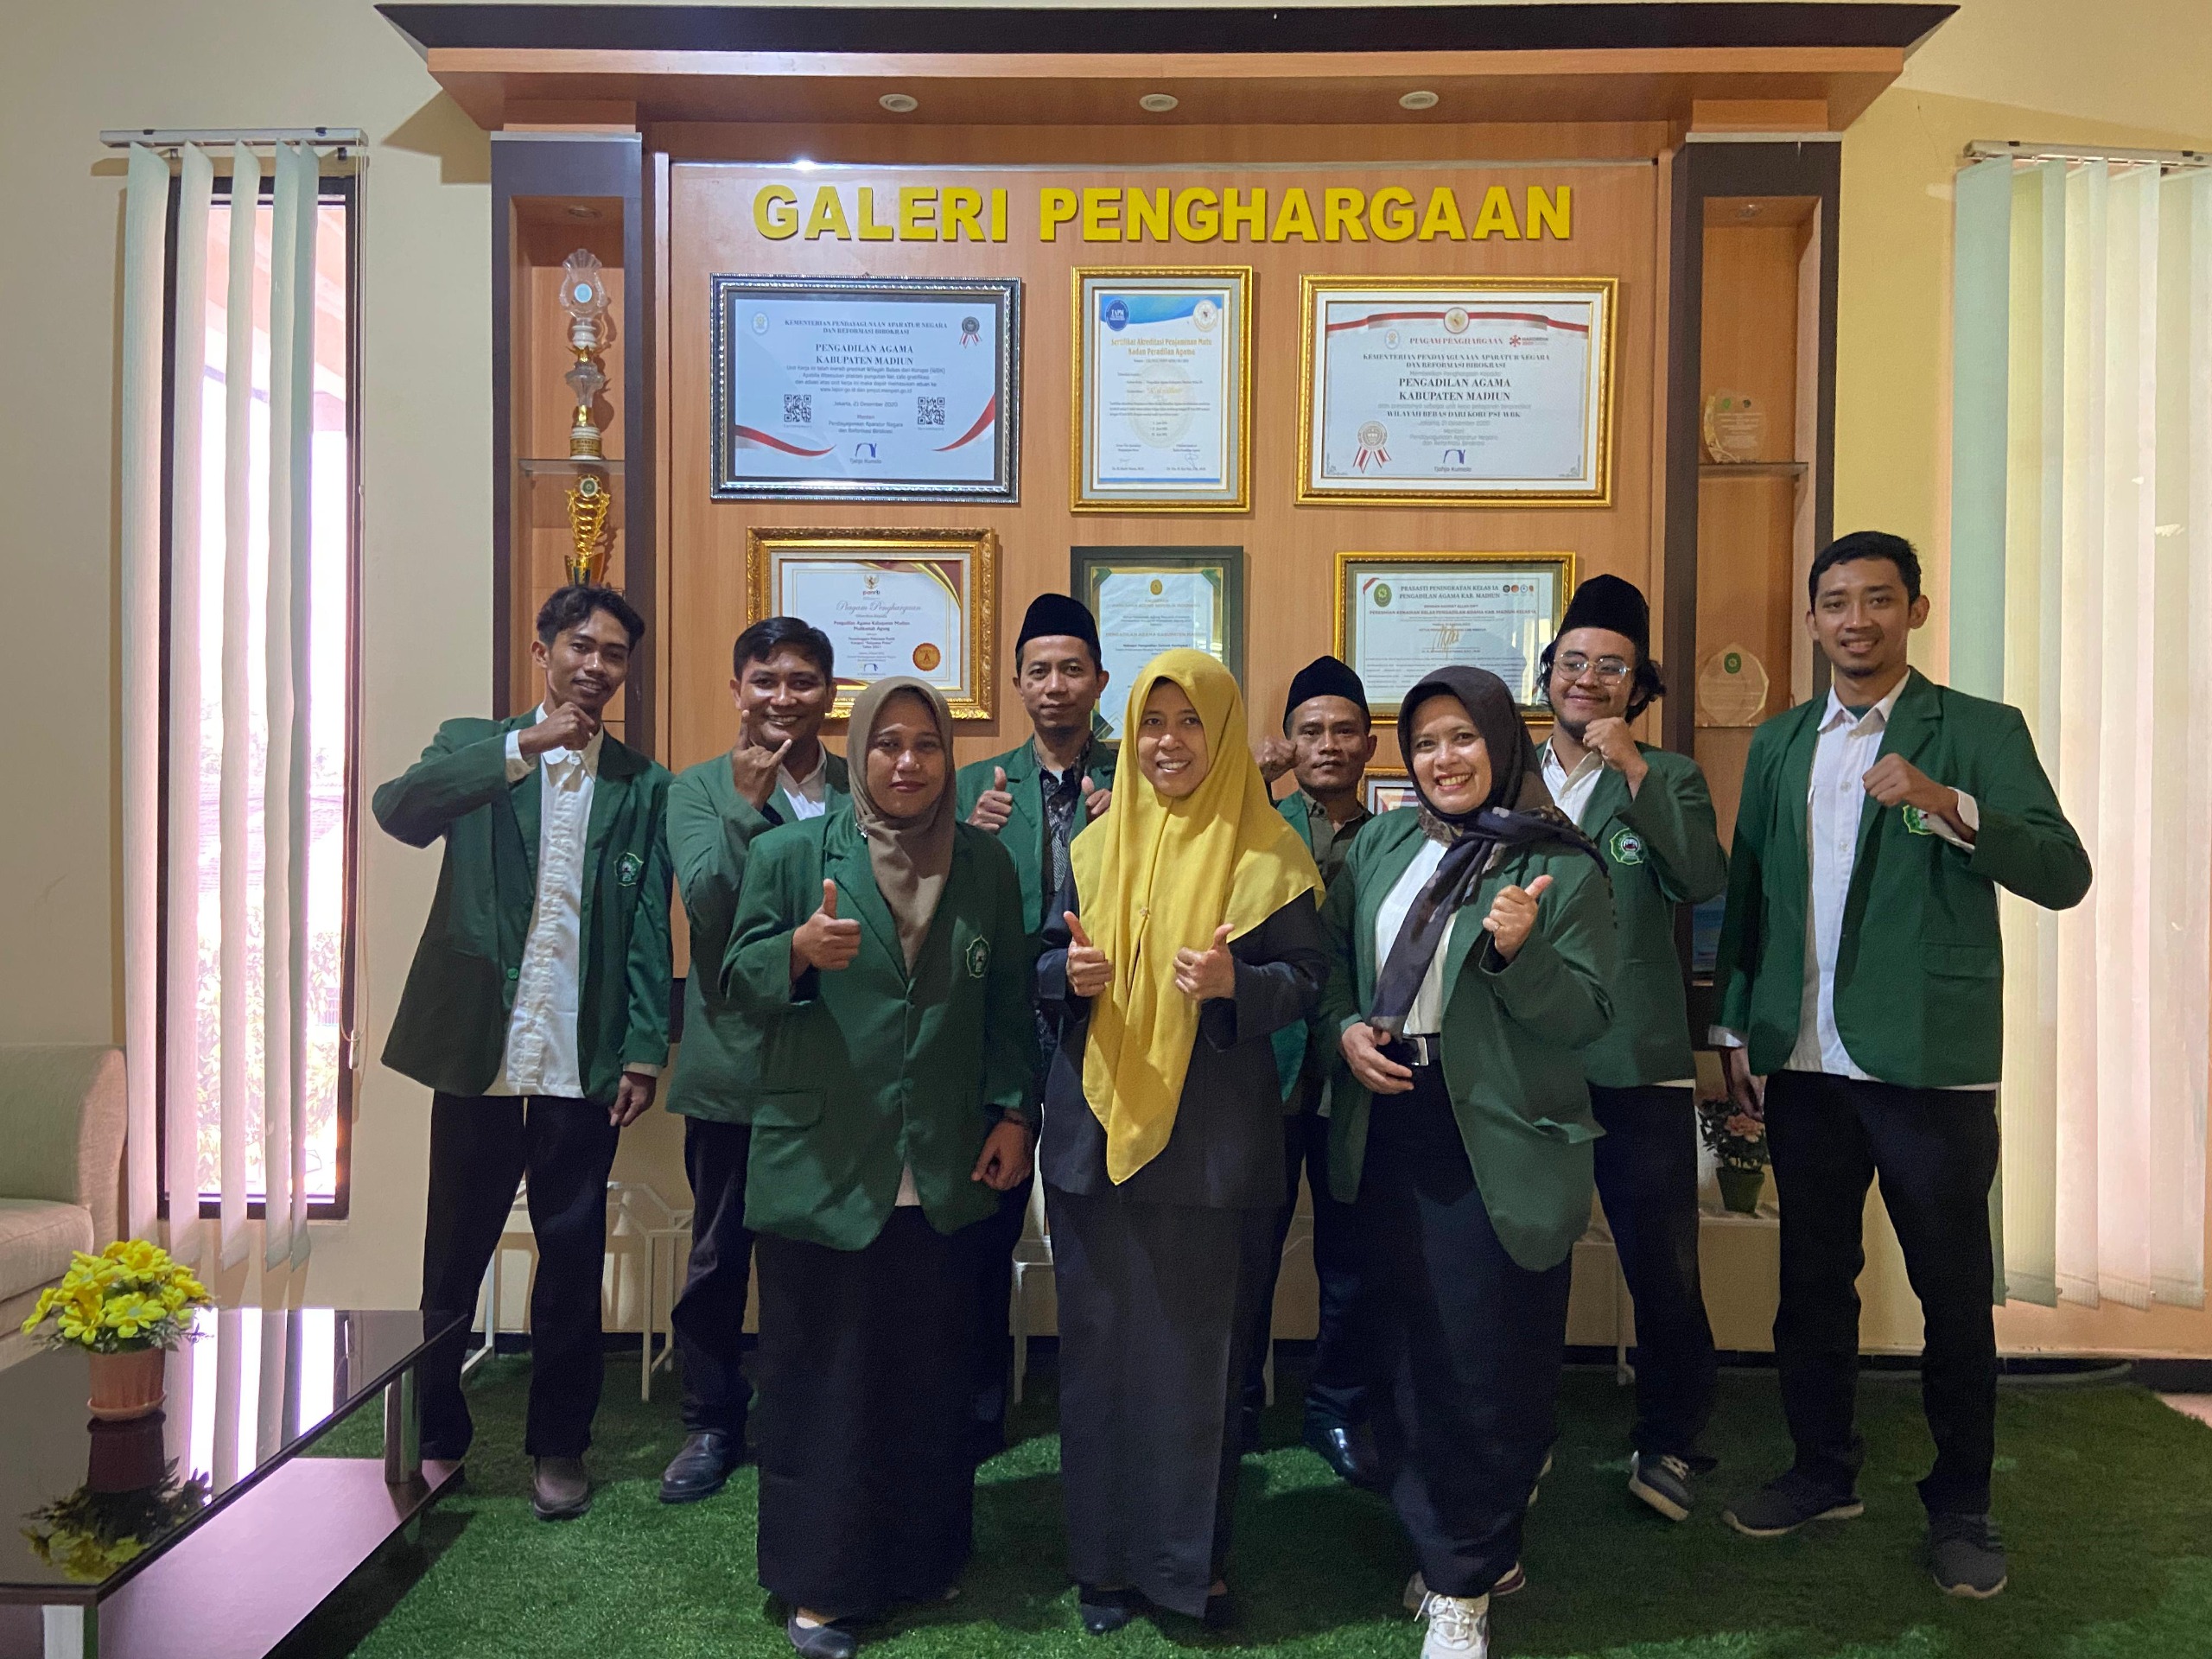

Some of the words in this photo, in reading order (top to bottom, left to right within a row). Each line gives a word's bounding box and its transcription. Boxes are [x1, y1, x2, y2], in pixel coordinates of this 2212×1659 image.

[753, 184, 1007, 241] GALERI
[1039, 186, 1572, 241] PENGHARGAAN
[816, 344, 876, 353] PENGADILAN
[880, 345, 913, 353] AGAMA
[1399, 378, 1468, 387] PENGADILAN
[1471, 378, 1511, 387] AGAMA
[1399, 391, 1463, 400] KABUPATEN
[836, 601, 868, 614] Piagam
[869, 601, 921, 614] Penghargaan
